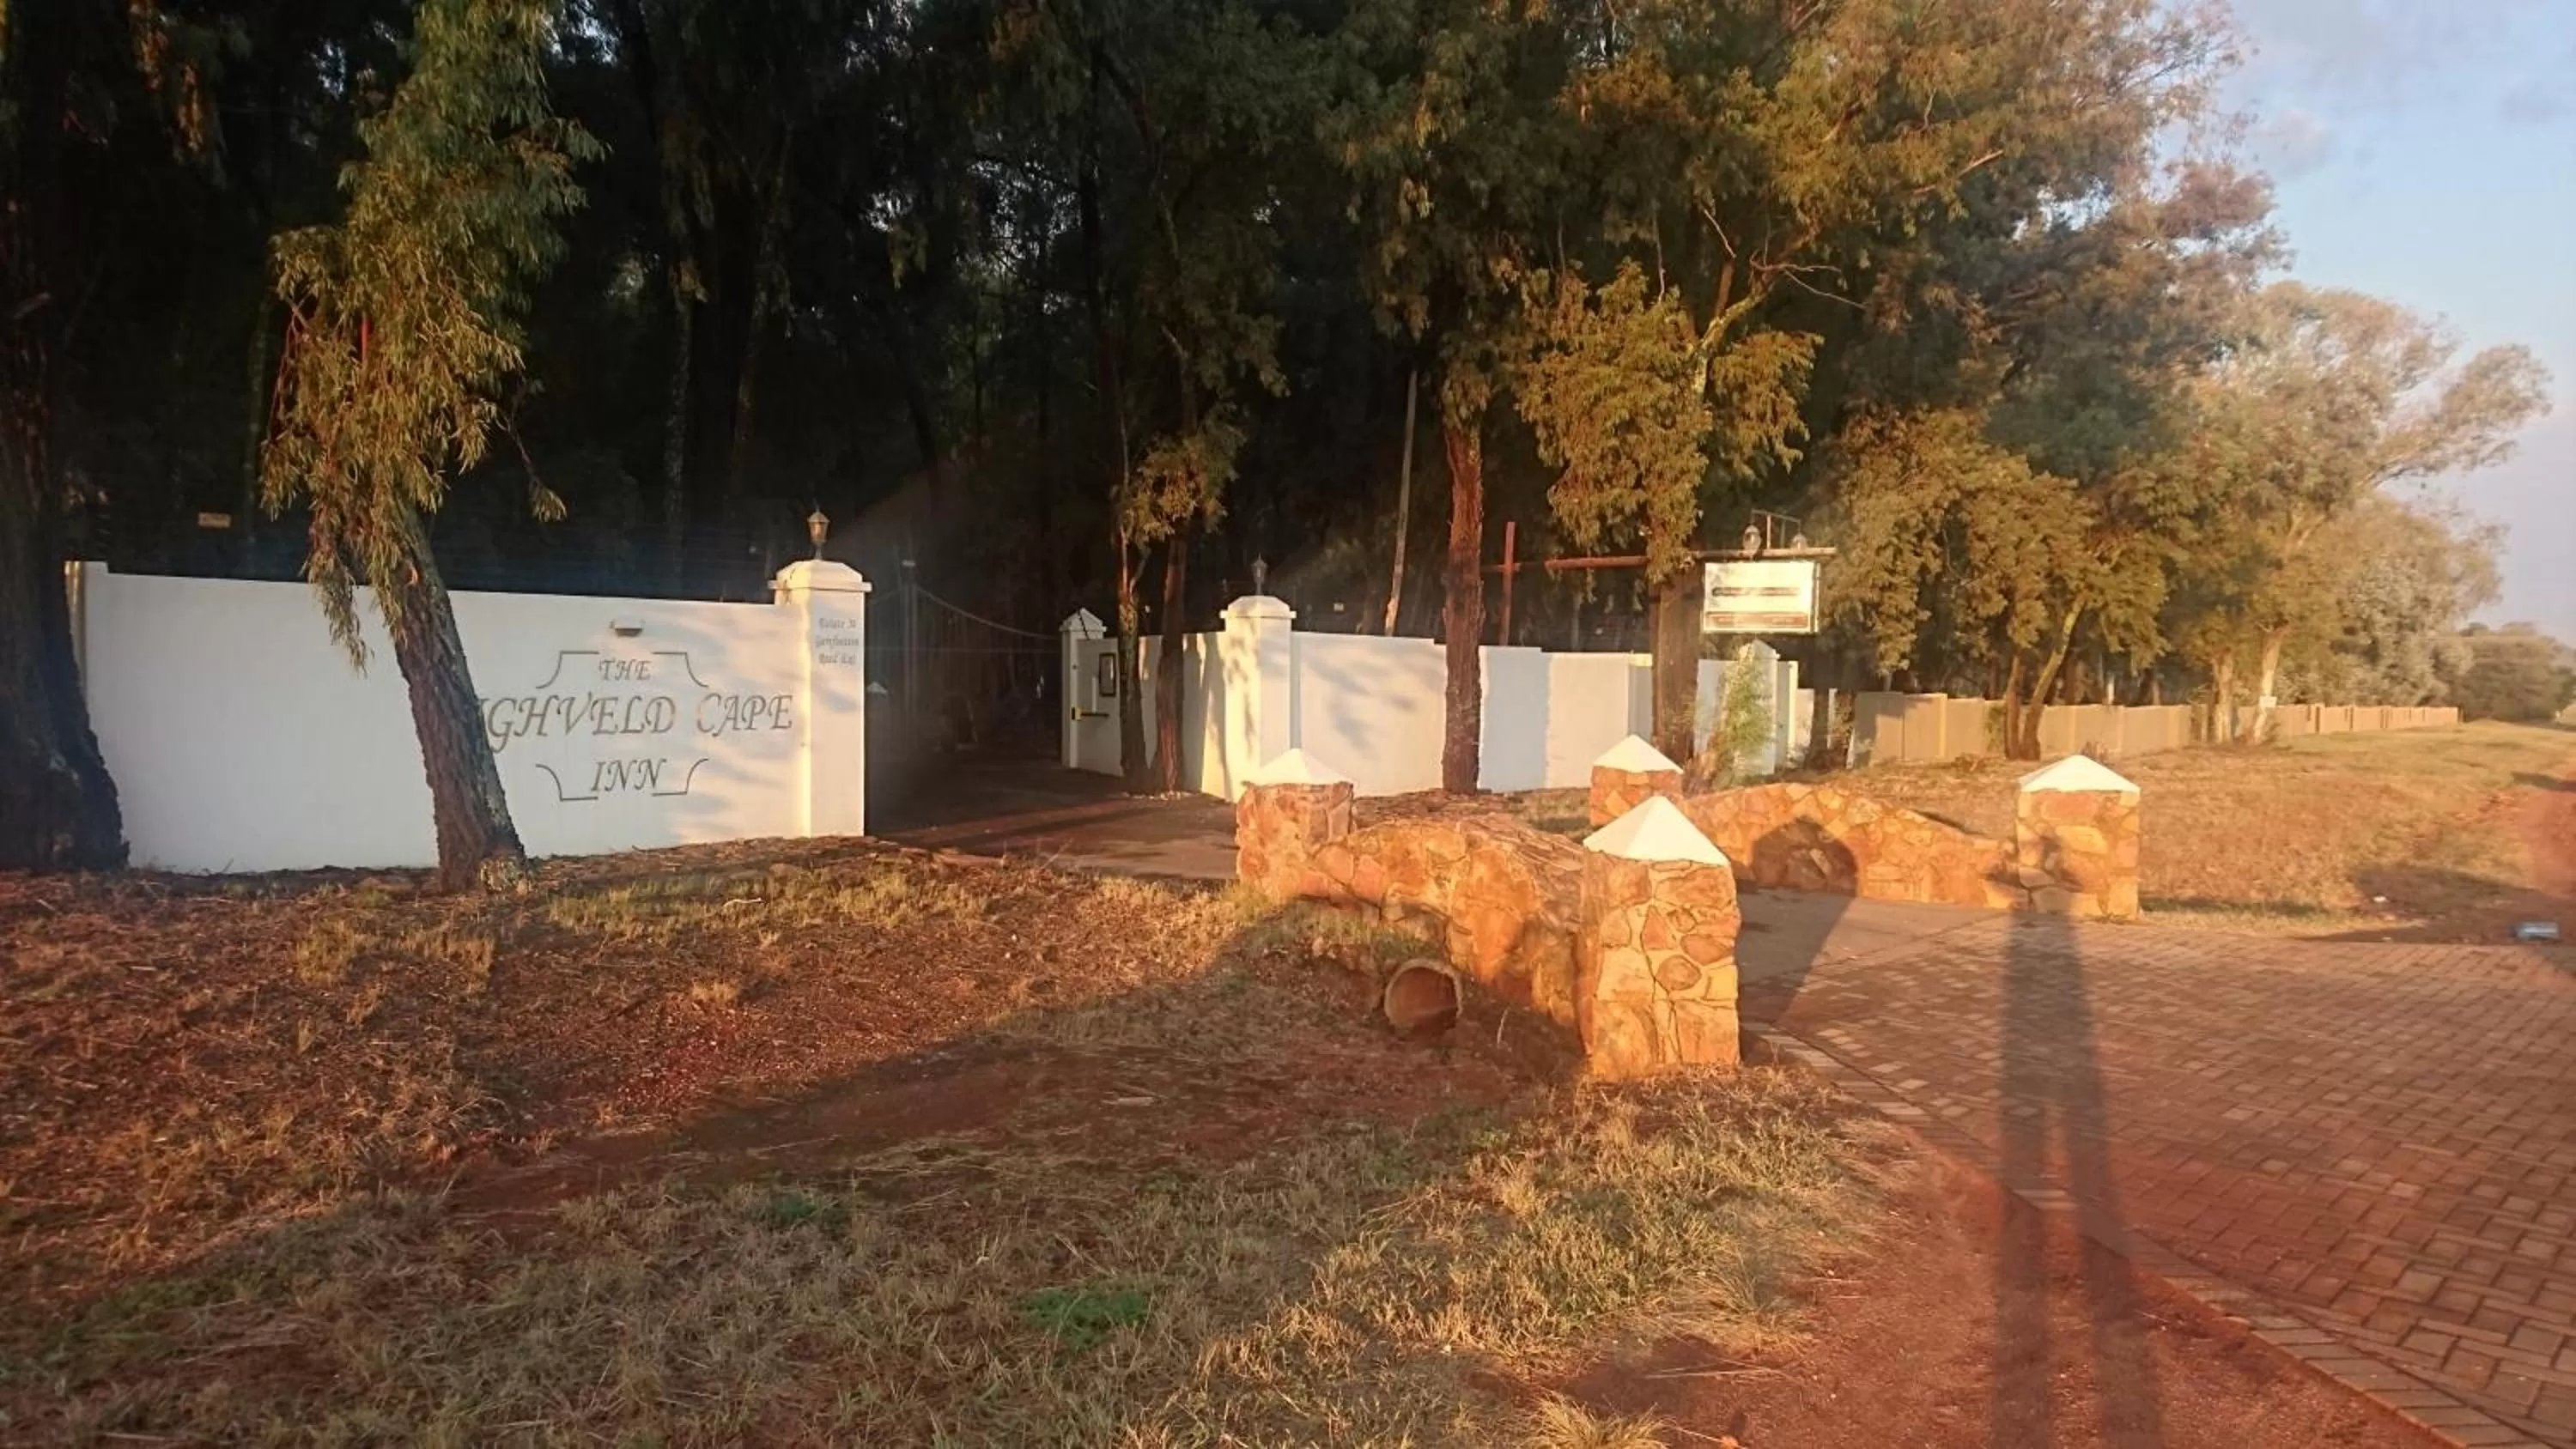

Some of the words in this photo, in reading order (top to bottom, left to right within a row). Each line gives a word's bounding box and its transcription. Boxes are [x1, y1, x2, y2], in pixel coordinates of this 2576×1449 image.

[599, 658, 653, 681] THE
[479, 691, 677, 754] GHVELD
[696, 692, 793, 737] CAPE
[590, 758, 667, 792] INN
